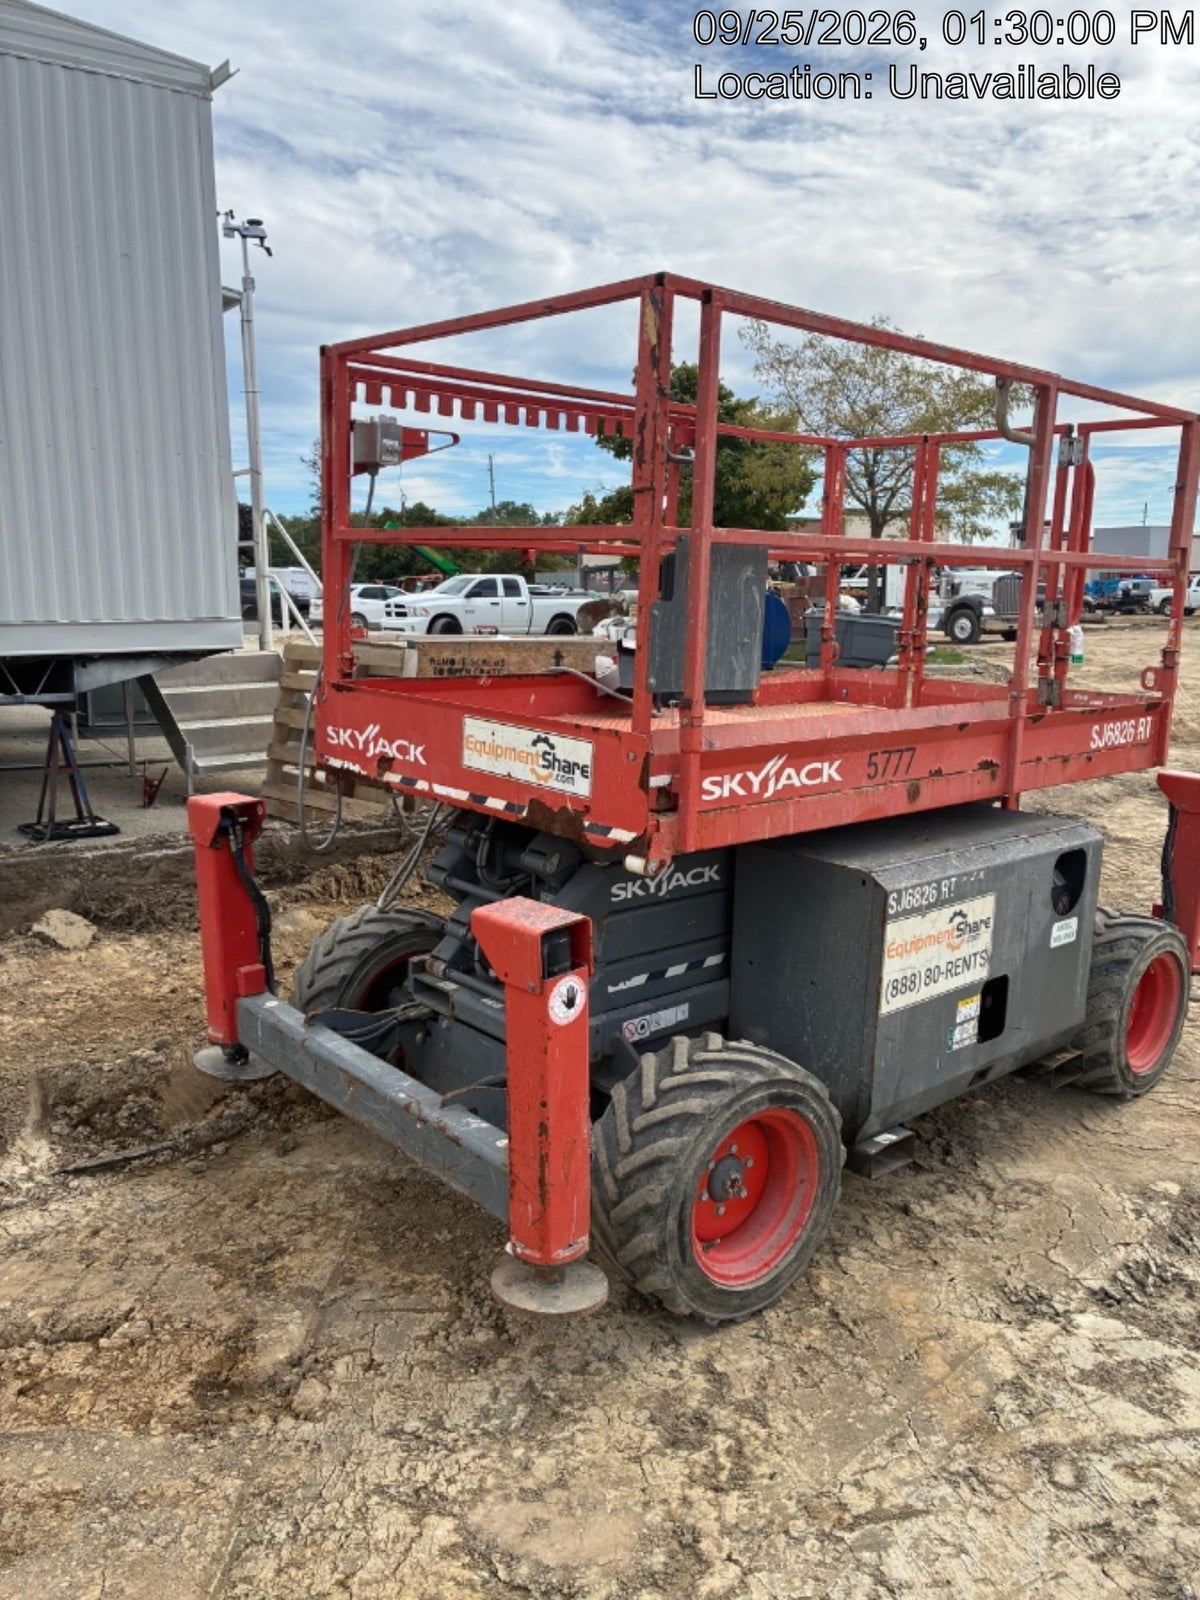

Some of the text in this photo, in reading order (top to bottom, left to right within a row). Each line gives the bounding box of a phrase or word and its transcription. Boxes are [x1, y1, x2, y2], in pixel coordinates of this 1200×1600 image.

[326, 723, 427, 765] SKYJACK
[1090, 716, 1153, 749] SJ6826 RT
[701, 754, 842, 800] SKYJACK
[866, 746, 917, 780] 5777
[610, 864, 720, 902] SKYJACK
[888, 884, 937, 914] SJ6826
[884, 949, 987, 1005] (888) 80-RENTS
